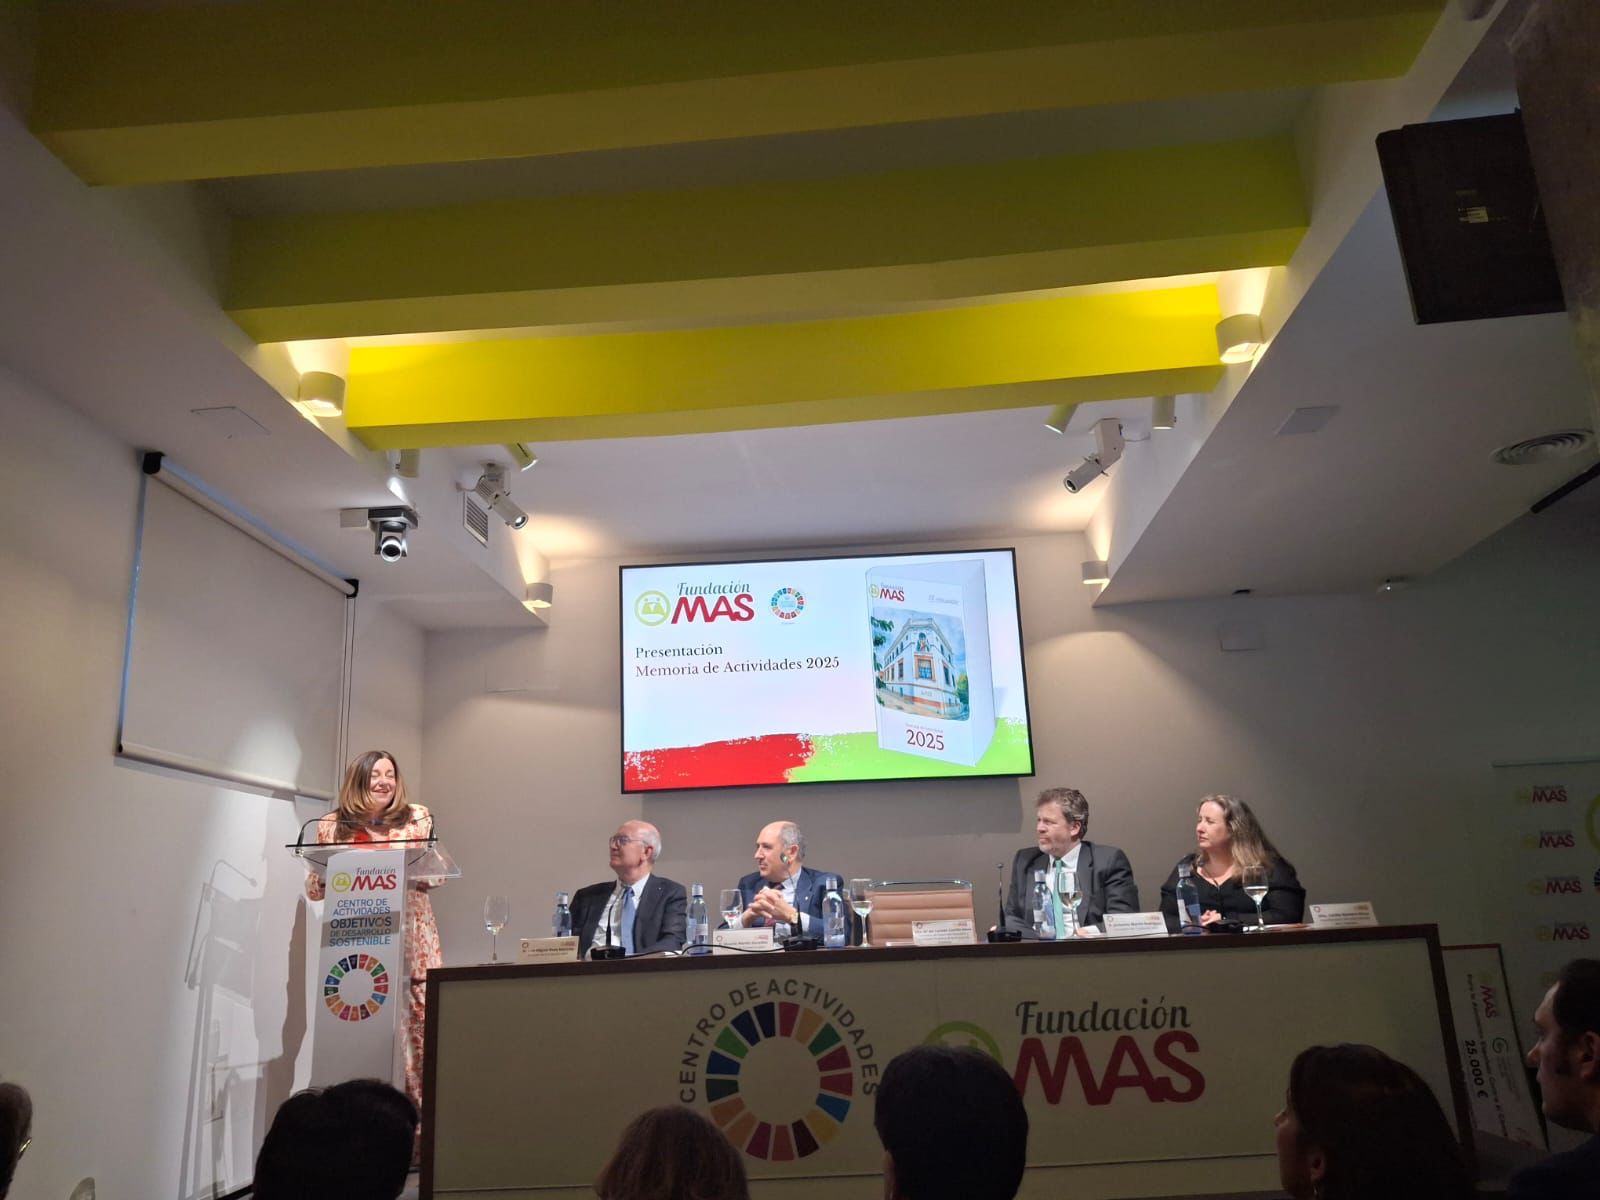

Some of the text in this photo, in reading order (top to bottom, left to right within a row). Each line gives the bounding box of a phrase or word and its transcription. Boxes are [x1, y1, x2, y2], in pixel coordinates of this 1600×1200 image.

[676, 579, 751, 596] Fundación
[879, 588, 905, 602] MAS
[671, 593, 755, 625] MAS
[635, 643, 723, 659] Presentación
[635, 656, 840, 677] Memoria de Actividades 2025
[906, 729, 945, 751] 2025
[1532, 789, 1568, 803] MAS
[1539, 834, 1575, 848] MAS
[351, 874, 397, 891] MAS
[1545, 880, 1582, 894] MAS
[333, 906, 391, 916] ACTIVIDADES
[337, 898, 388, 908] CENTRO DE
[330, 916, 392, 929] OBJETIVOS
[342, 928, 392, 937] DESARROLLO
[1552, 926, 1590, 941] MAS
[329, 936, 391, 947] SOSTENIBLE
[1480, 985, 1500, 1019] MAS
[1015, 995, 1191, 1036] Fundación
[679, 978, 880, 1103] CENTRO DE ACTIVIDADES
[1013, 1030, 1206, 1106] MAS
[1465, 1039, 1484, 1086] 25.000
